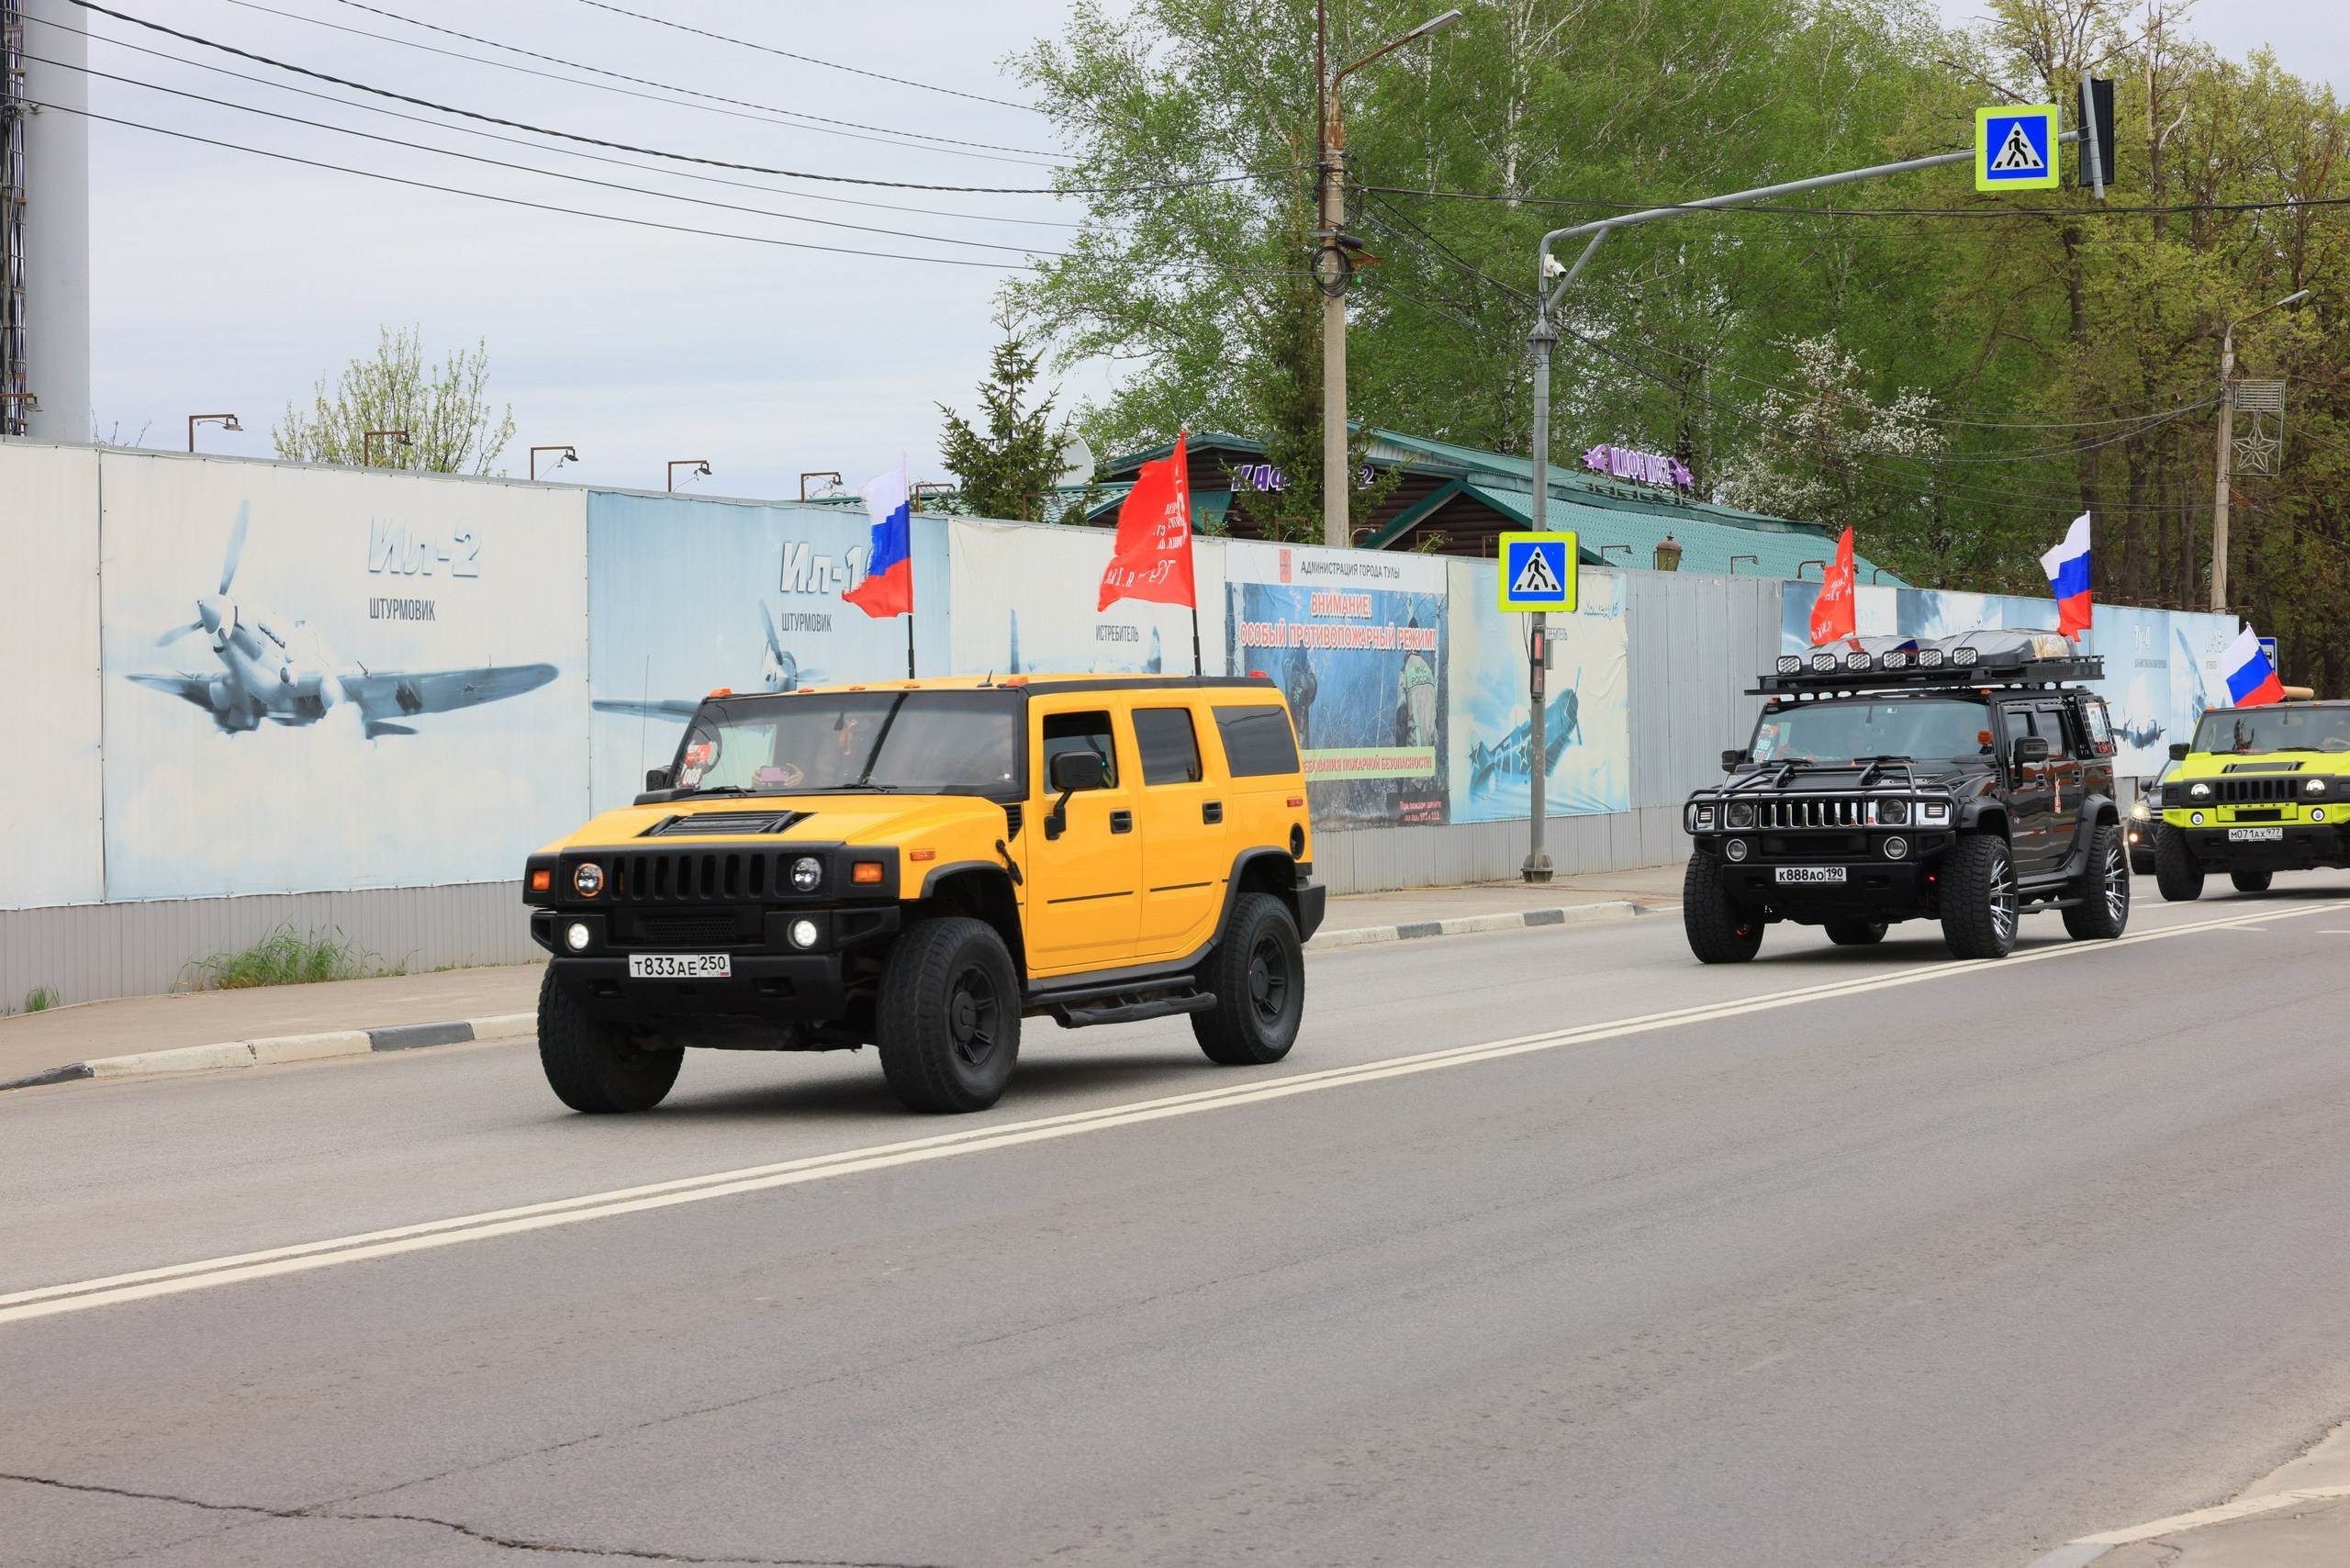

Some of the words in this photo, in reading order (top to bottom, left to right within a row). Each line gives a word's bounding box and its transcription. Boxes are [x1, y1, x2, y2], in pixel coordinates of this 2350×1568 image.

[1610, 447, 1646, 480] КАФЕ
[1231, 464, 1292, 491] КАФ
[368, 515, 482, 578] Ил-2
[780, 543, 875, 594] Ил-1
[1301, 561, 1358, 577] АДМИНИСТРАЦИЯ
[1360, 564, 1382, 577] ГОРОДА
[1383, 566, 1401, 579] ТУЛЫ
[369, 598, 436, 622] ШТУРМОВИК
[1311, 592, 1372, 618] ВНИМАНИЕ!
[781, 613, 833, 633] ШТУРМОВИК
[1095, 624, 1139, 643] ИСТРЕБИТЕЛЬ
[1240, 619, 1287, 648] ОСОБЫЙ
[1288, 622, 1395, 651] ПРОТИВОПОЖАРНЫЙ
[1397, 627, 1437, 652] РЕЖИМ!
[1414, 666, 1427, 674] МЧС
[1304, 757, 1342, 773] ЕБОВАНИЯ
[1342, 754, 1381, 772] ПОЖАРНОЙ
[2231, 830, 2266, 838] М071АХ
[1779, 868, 1824, 881] К888АО
[1826, 868, 1843, 878] 190
[634, 957, 698, 976] Т833АЕ
[699, 956, 726, 970] 250
